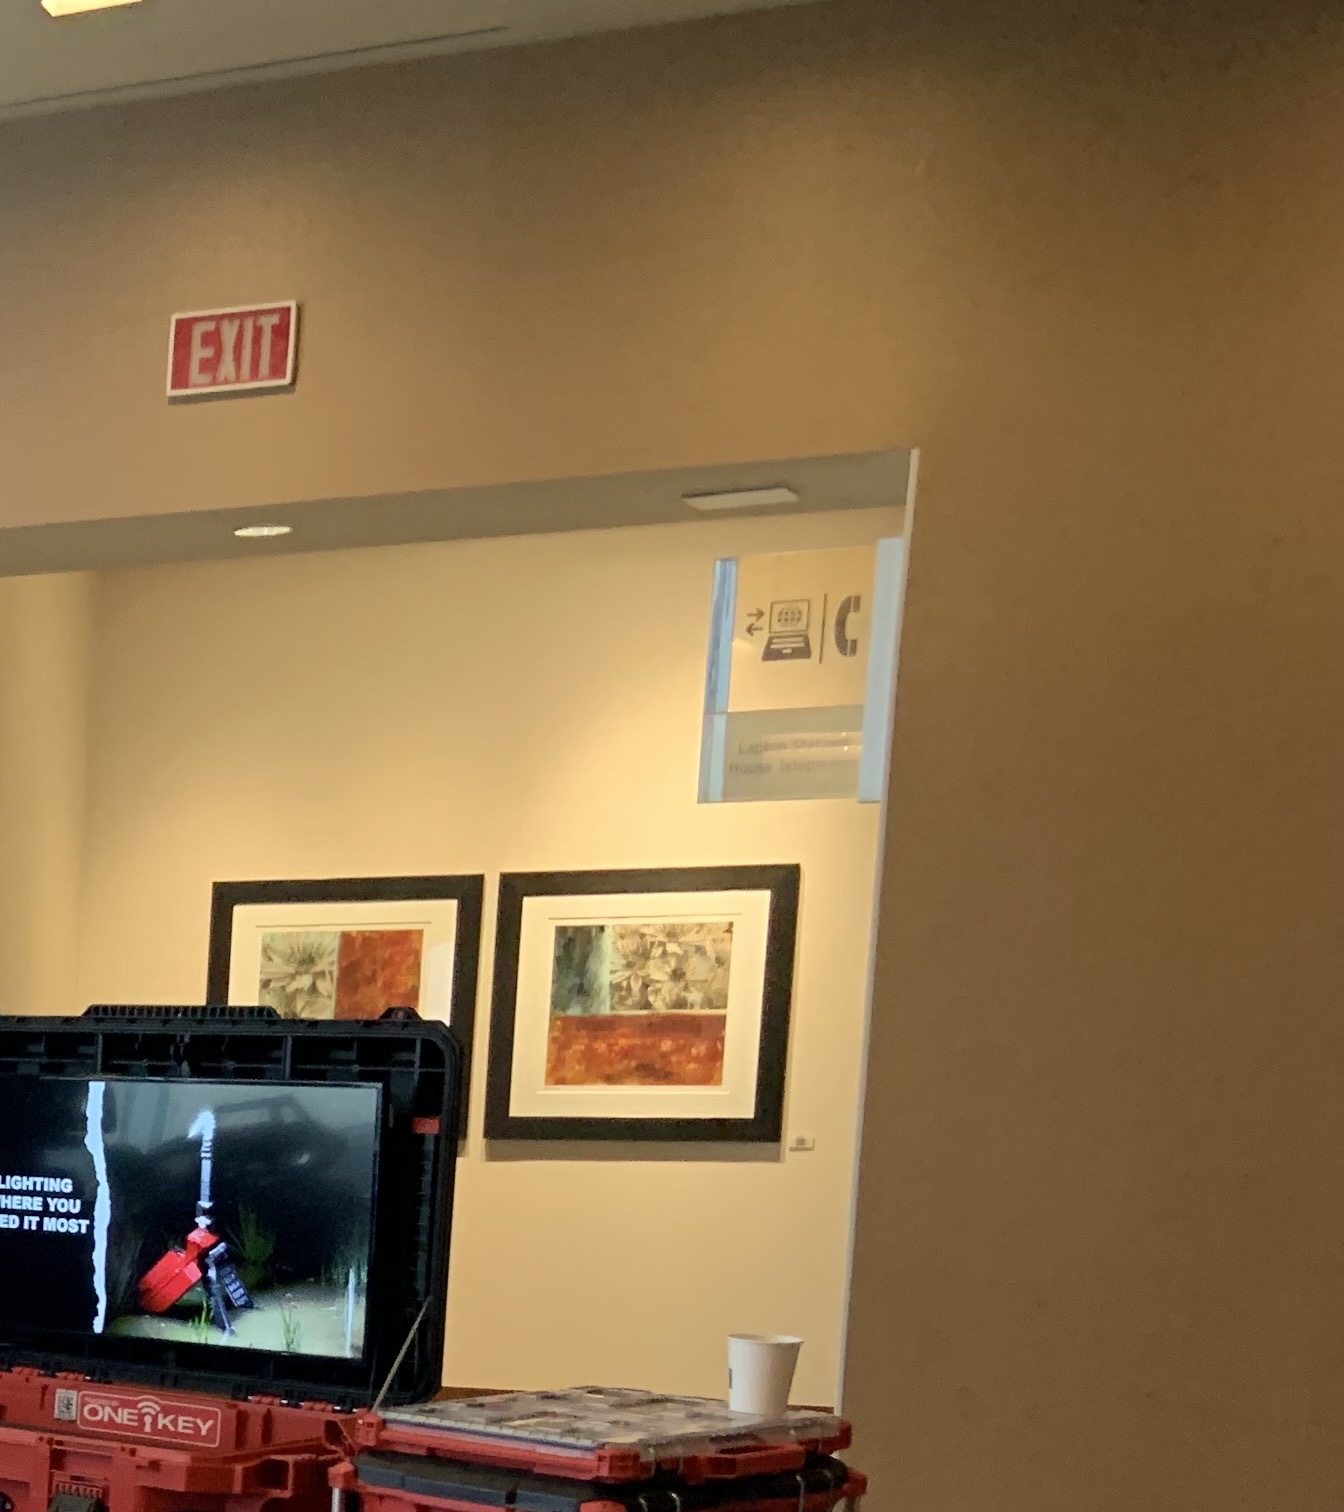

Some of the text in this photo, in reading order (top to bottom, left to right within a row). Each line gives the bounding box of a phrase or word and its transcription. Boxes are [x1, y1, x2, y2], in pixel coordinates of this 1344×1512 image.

[189, 313, 280, 387] EXIT
[47, 1198, 81, 1214] YOU
[23, 1216, 40, 1230] IT
[43, 1217, 90, 1234] MOST
